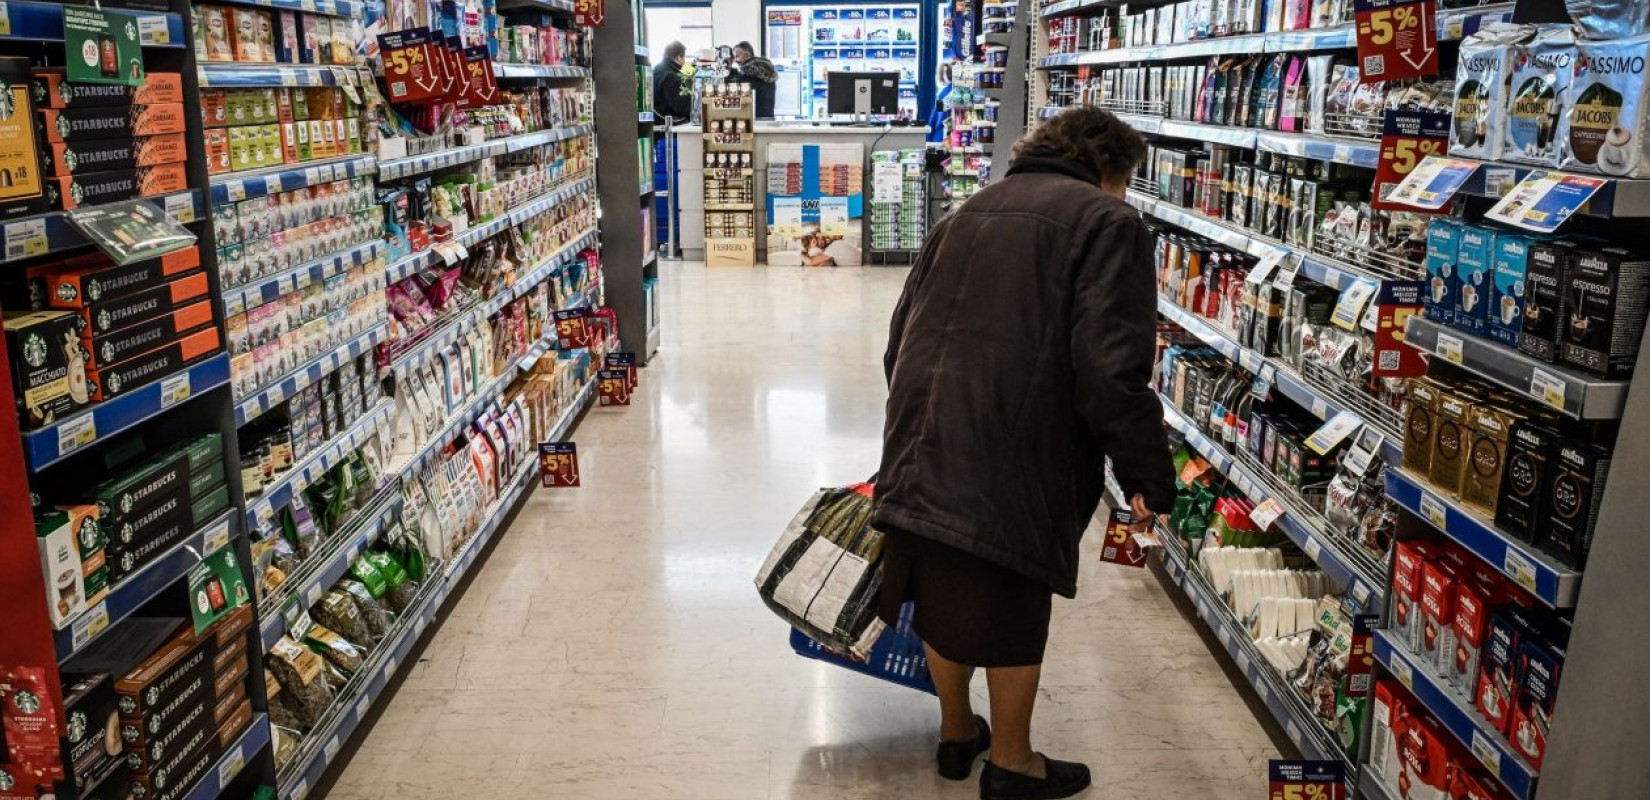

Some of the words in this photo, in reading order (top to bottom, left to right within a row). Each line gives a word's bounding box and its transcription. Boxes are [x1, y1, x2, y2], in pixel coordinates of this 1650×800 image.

[1360, 7, 1418, 45] -5%
[385, 47, 424, 75] -5%
[1585, 56, 1645, 74] TASSIMO
[74, 86, 124, 97] STARBUCKS
[1516, 102, 1545, 114] JACOBS
[1576, 110, 1612, 124] JACOBS
[72, 118, 125, 130] STARBUCKS
[152, 114, 176, 122] CARAMEL
[79, 149, 128, 163] STARBUCKS
[1383, 139, 1441, 174] -5%
[84, 180, 132, 196] STARBUCKS
[713, 243, 748, 252] FERRERO
[1580, 257, 1608, 271] LAVAZZA
[102, 271, 149, 291] STARBUCKS
[1527, 272, 1558, 287] espresso
[1572, 279, 1610, 295] espresso
[112, 299, 158, 321] STARBUCKS
[558, 318, 581, 335] -5%
[115, 328, 162, 352] STARBUCKS
[29, 367, 66, 387] MACCHIATO
[121, 359, 168, 383] STARBUCKS
[599, 379, 622, 393] -5%
[1478, 415, 1502, 431] LAVAZZA
[1516, 429, 1540, 446] LAVAZZA
[542, 455, 569, 471] -5%
[1561, 447, 1584, 466] LAVAZZA
[133, 471, 177, 502] STARBUCKS
[133, 498, 177, 532] STARBUCKS
[133, 526, 179, 559] STARBUCKS
[160, 652, 205, 692] STARBUCKS
[161, 677, 202, 718] STARBUCKS
[164, 704, 204, 746] STARBUCKS
[71, 728, 106, 762] CAPPUCCINO
[166, 729, 205, 775] STARBUCKS
[170, 755, 209, 800] STARBUCKS
